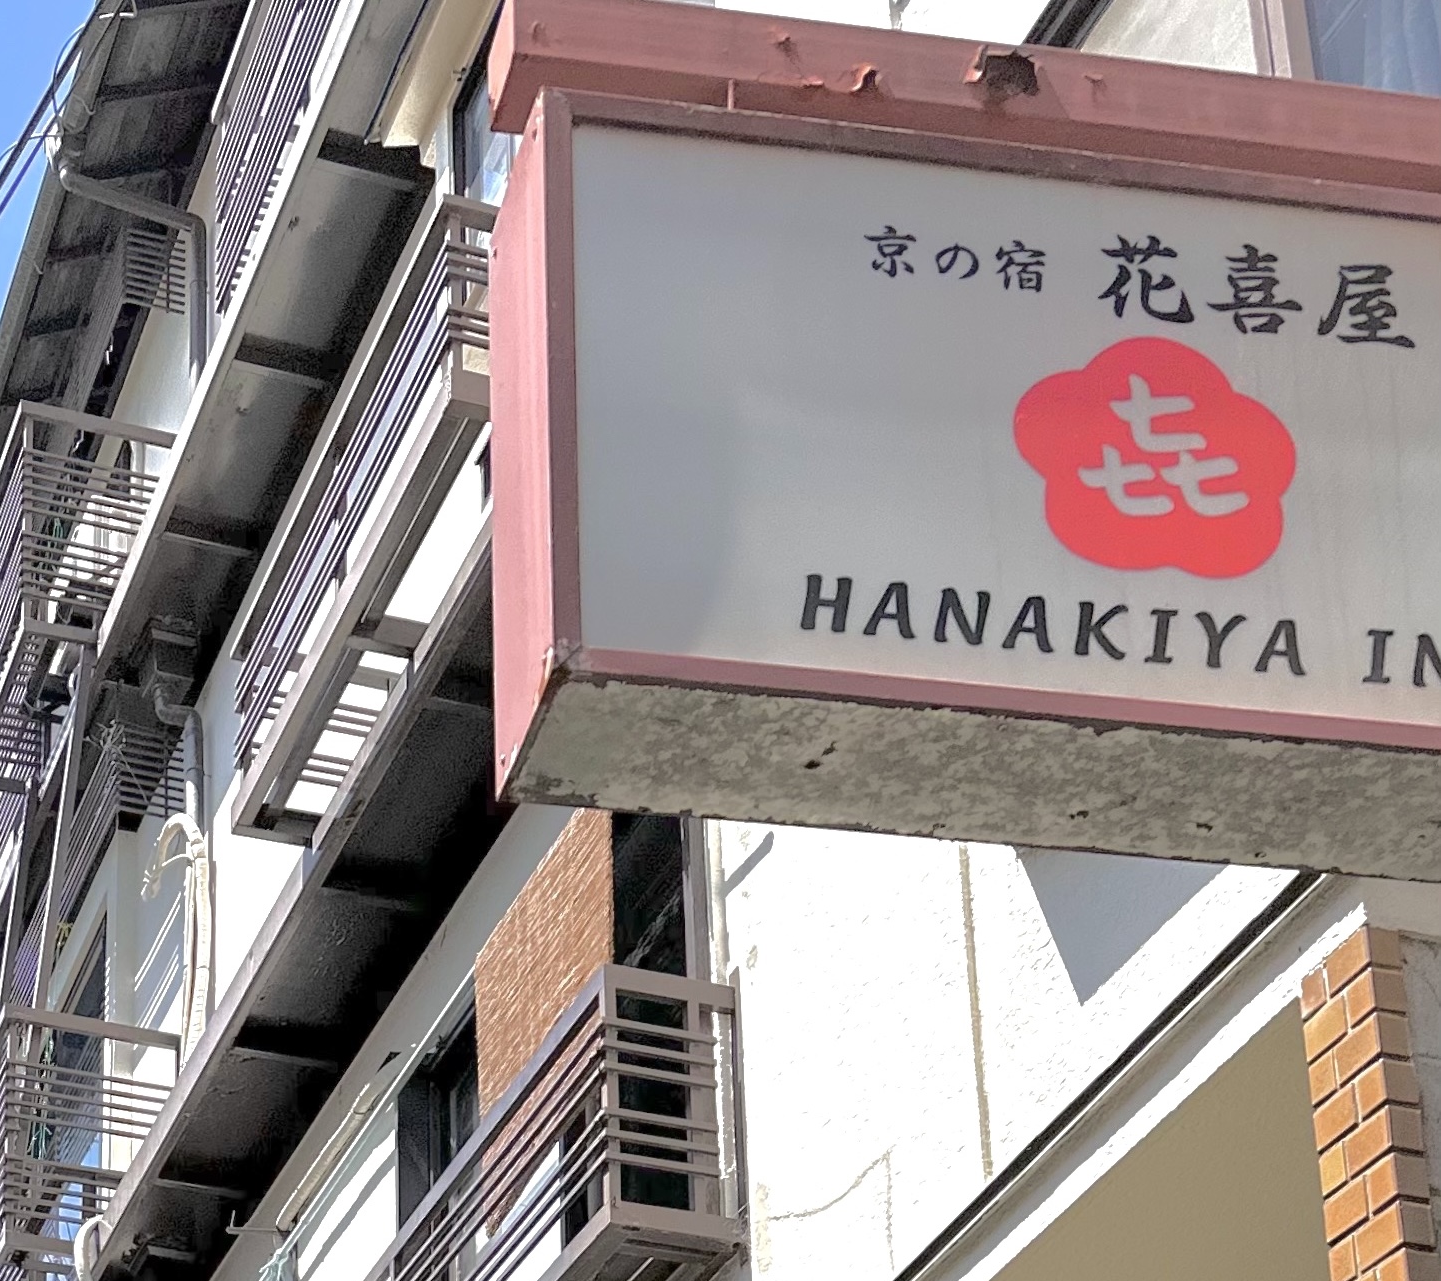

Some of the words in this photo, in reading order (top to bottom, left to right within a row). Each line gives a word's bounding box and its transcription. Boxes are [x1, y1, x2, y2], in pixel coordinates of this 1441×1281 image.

[863, 225, 1047, 294] 京の宿
[1098, 233, 1417, 350] 花喜屋
[799, 573, 1307, 677] HANAKIYA
